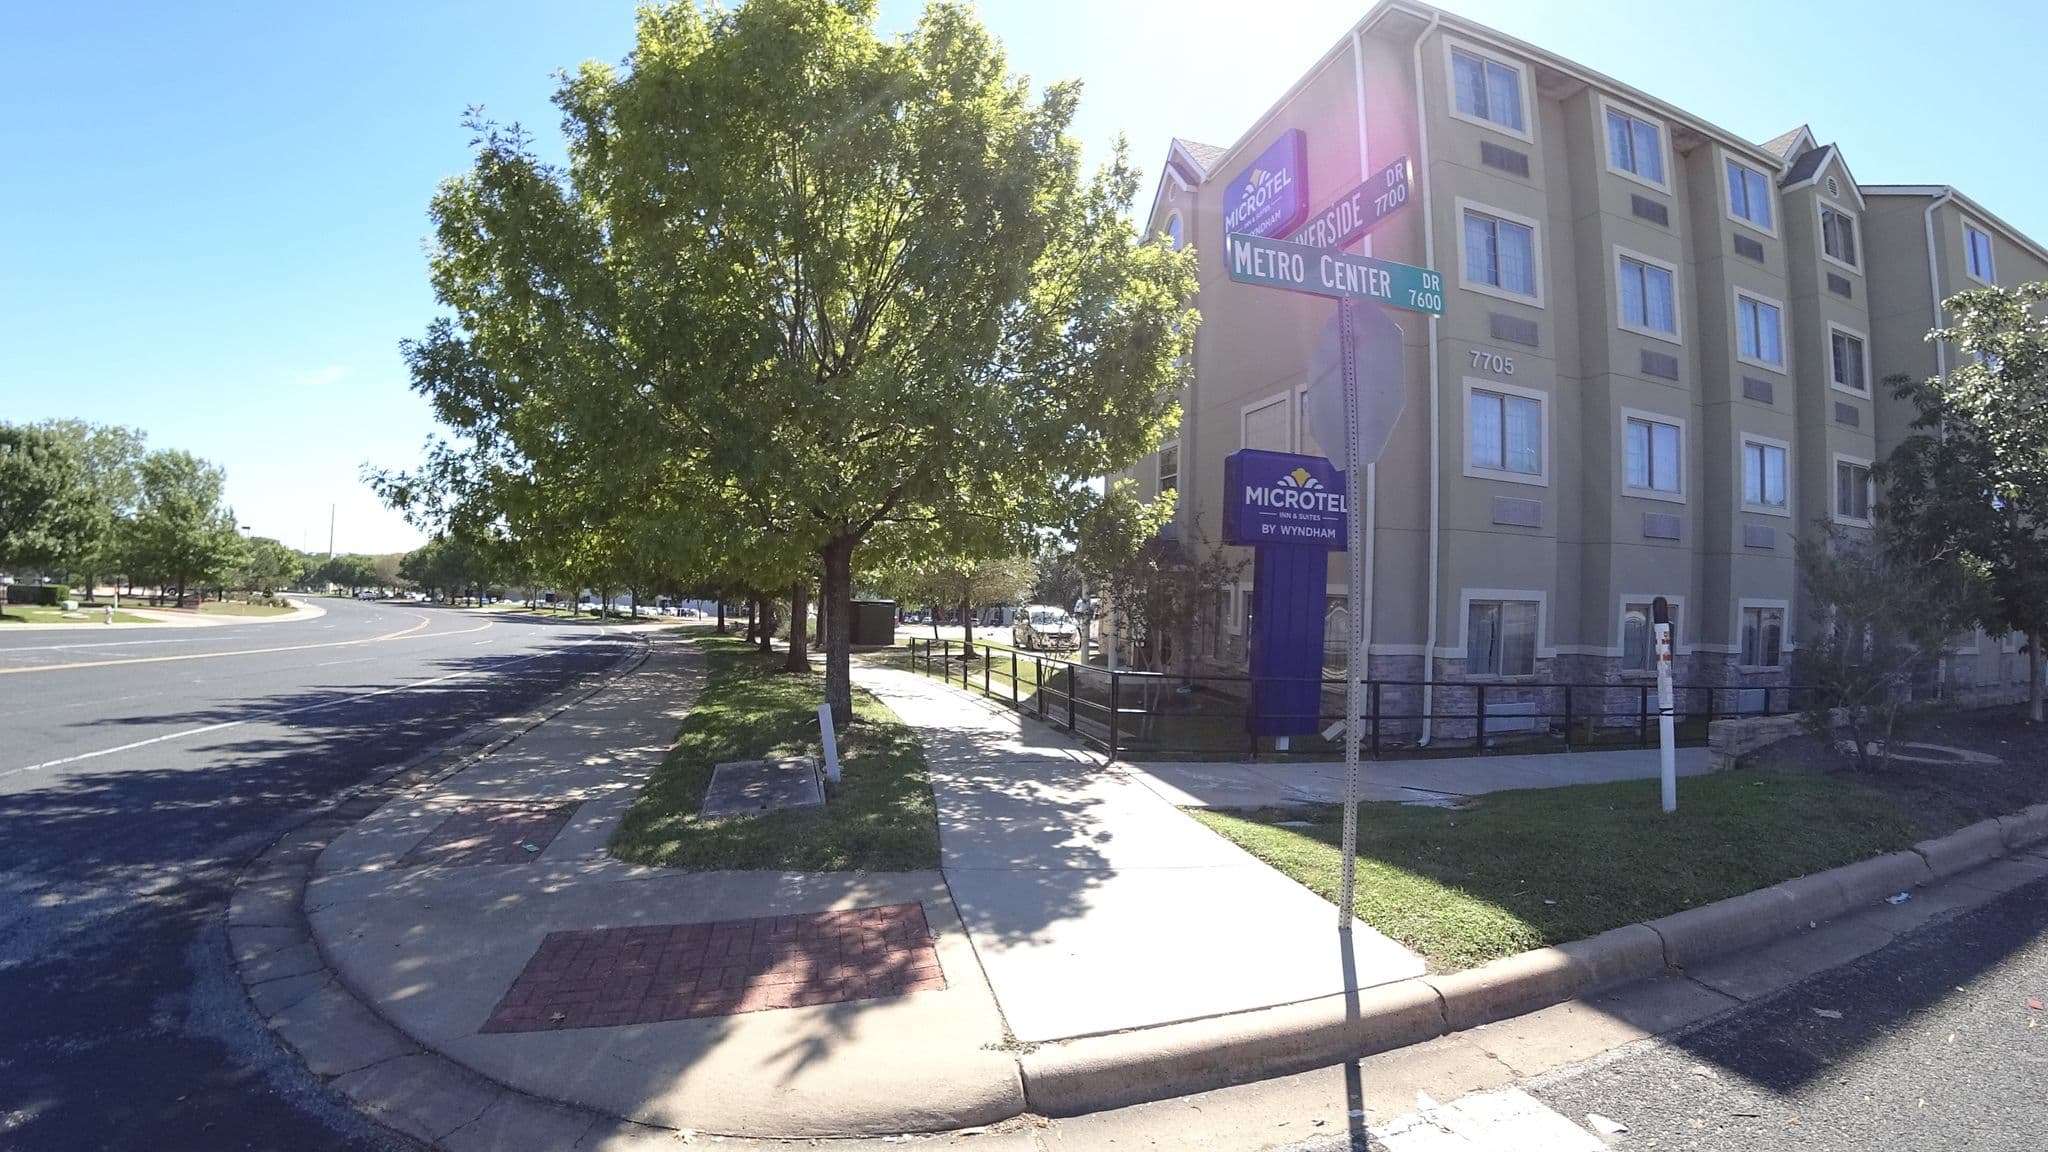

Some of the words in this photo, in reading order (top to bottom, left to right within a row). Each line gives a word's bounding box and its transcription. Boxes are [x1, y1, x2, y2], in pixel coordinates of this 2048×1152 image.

[1225, 168, 1292, 233] MICROTEL
[1295, 192, 1363, 249] VERSIDE
[1386, 162, 1404, 187] DR
[1374, 184, 1405, 217] 7700
[1233, 240, 1305, 284] METRO
[1320, 254, 1392, 298] CENTER
[1422, 272, 1440, 292] DR
[1408, 289, 1442, 311] 7600
[1469, 350, 1515, 375] 7705
[1245, 486, 1348, 513] MICROTEL
[1261, 523, 1277, 535] BY
[1280, 525, 1336, 539] WYNDHAM
